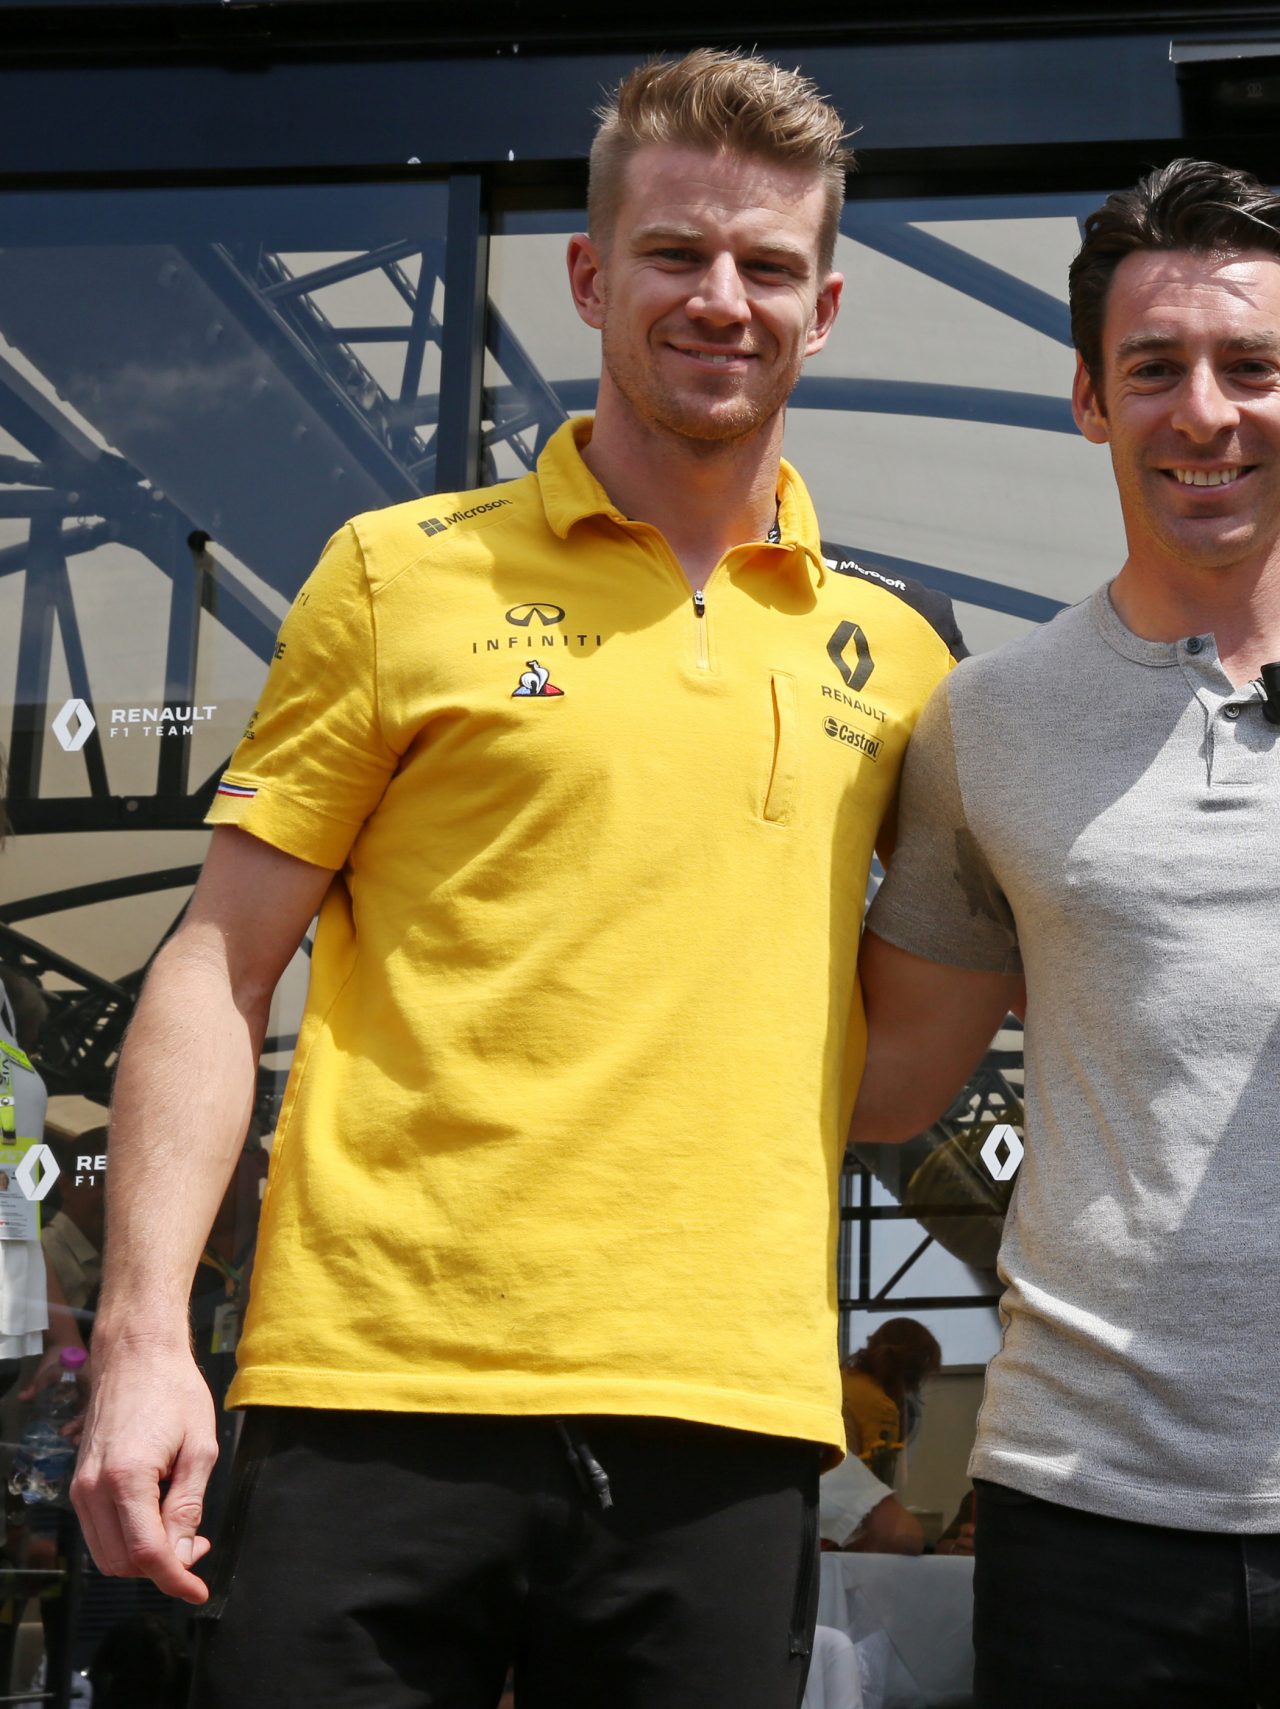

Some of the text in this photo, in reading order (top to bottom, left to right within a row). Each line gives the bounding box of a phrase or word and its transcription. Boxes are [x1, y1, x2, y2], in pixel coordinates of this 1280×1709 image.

[840, 561, 906, 591] Microsoft
[472, 634, 602, 654] INFINITI
[111, 705, 217, 723] RENAULT
[821, 685, 886, 723] RENAULT
[110, 725, 194, 738] F1 TEAM
[838, 724, 880, 758] Castrol
[75, 1175, 95, 1187] F1
